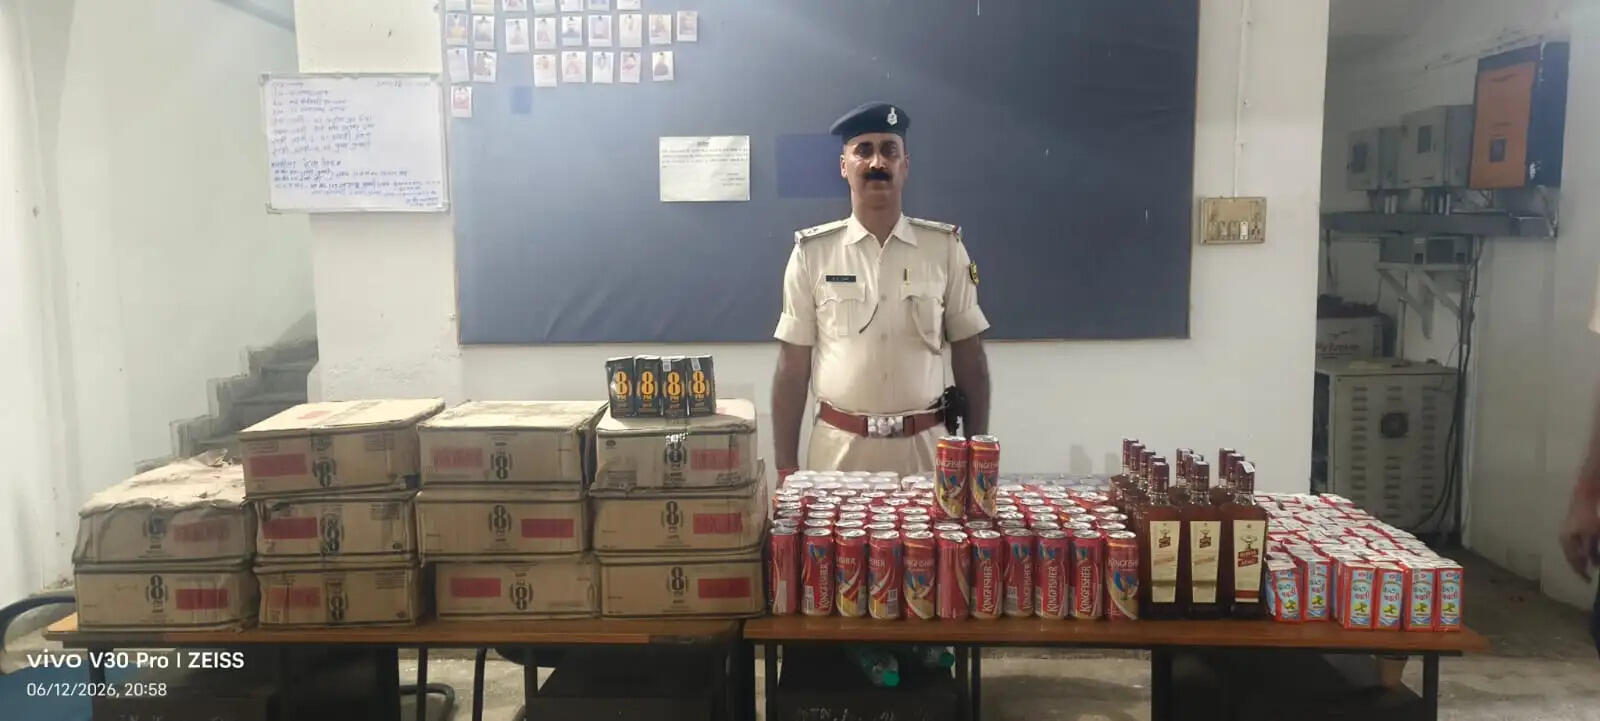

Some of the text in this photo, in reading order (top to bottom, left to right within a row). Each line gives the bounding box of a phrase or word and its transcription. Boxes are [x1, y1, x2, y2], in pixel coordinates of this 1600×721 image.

[615, 371, 628, 395] 8
[641, 371, 654, 395] 8
[667, 371, 680, 396] 8
[692, 371, 705, 394] 8
[494, 504, 507, 529] 8
[666, 501, 679, 525] 8
[150, 575, 164, 600] 8
[671, 566, 684, 590] 8
[983, 566, 993, 612] KINGFISHER
[1047, 566, 1058, 612] KINGFISHER
[1080, 566, 1091, 612] KINGFISHER
[331, 595, 344, 621] 8
